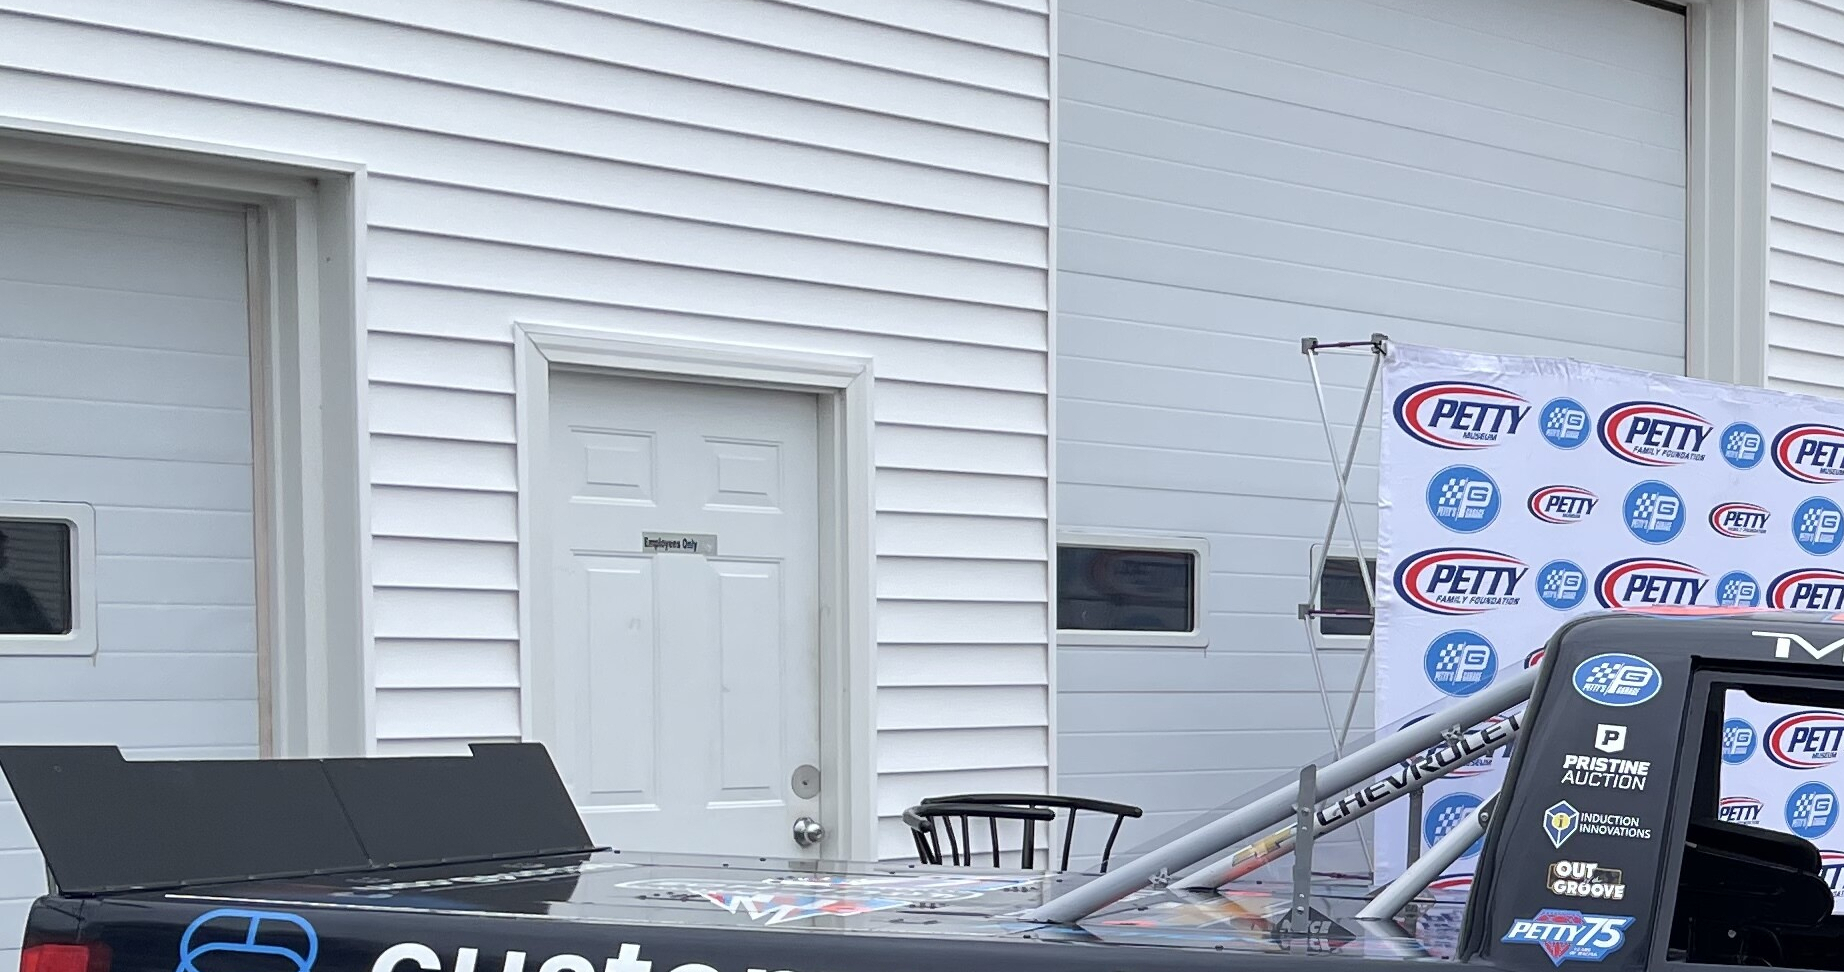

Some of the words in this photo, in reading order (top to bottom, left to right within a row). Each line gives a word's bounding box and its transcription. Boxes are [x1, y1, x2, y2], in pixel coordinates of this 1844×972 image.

[1427, 398, 1532, 435] PETTY
[1462, 431, 1498, 442] MUSEUM
[1625, 415, 1714, 452] PETTY
[1632, 445, 1661, 456] FAMILY
[1661, 449, 1706, 462] FOUNDATION
[1545, 495, 1599, 515] PETTY
[1722, 510, 1771, 529] PETTY
[644, 536, 681, 551] Employees
[682, 537, 698, 552] Only
[1426, 563, 1529, 596] PETTY
[1622, 573, 1710, 605] PETTY
[1435, 594, 1468, 605] FAMILY
[1469, 596, 1521, 606] FOUNDATION
[1562, 754, 1651, 776] PRISTINE
[1560, 769, 1647, 791] AUCTION
[1580, 812, 1640, 827] INDUCTION
[1720, 803, 1764, 822] PETTY
[1579, 823, 1651, 839] INNOVATIONS
[1554, 859, 1598, 879] OUT
[1552, 879, 1626, 900] GROOVE
[1508, 921, 1588, 942] PETTY
[1576, 916, 1627, 948] 75
